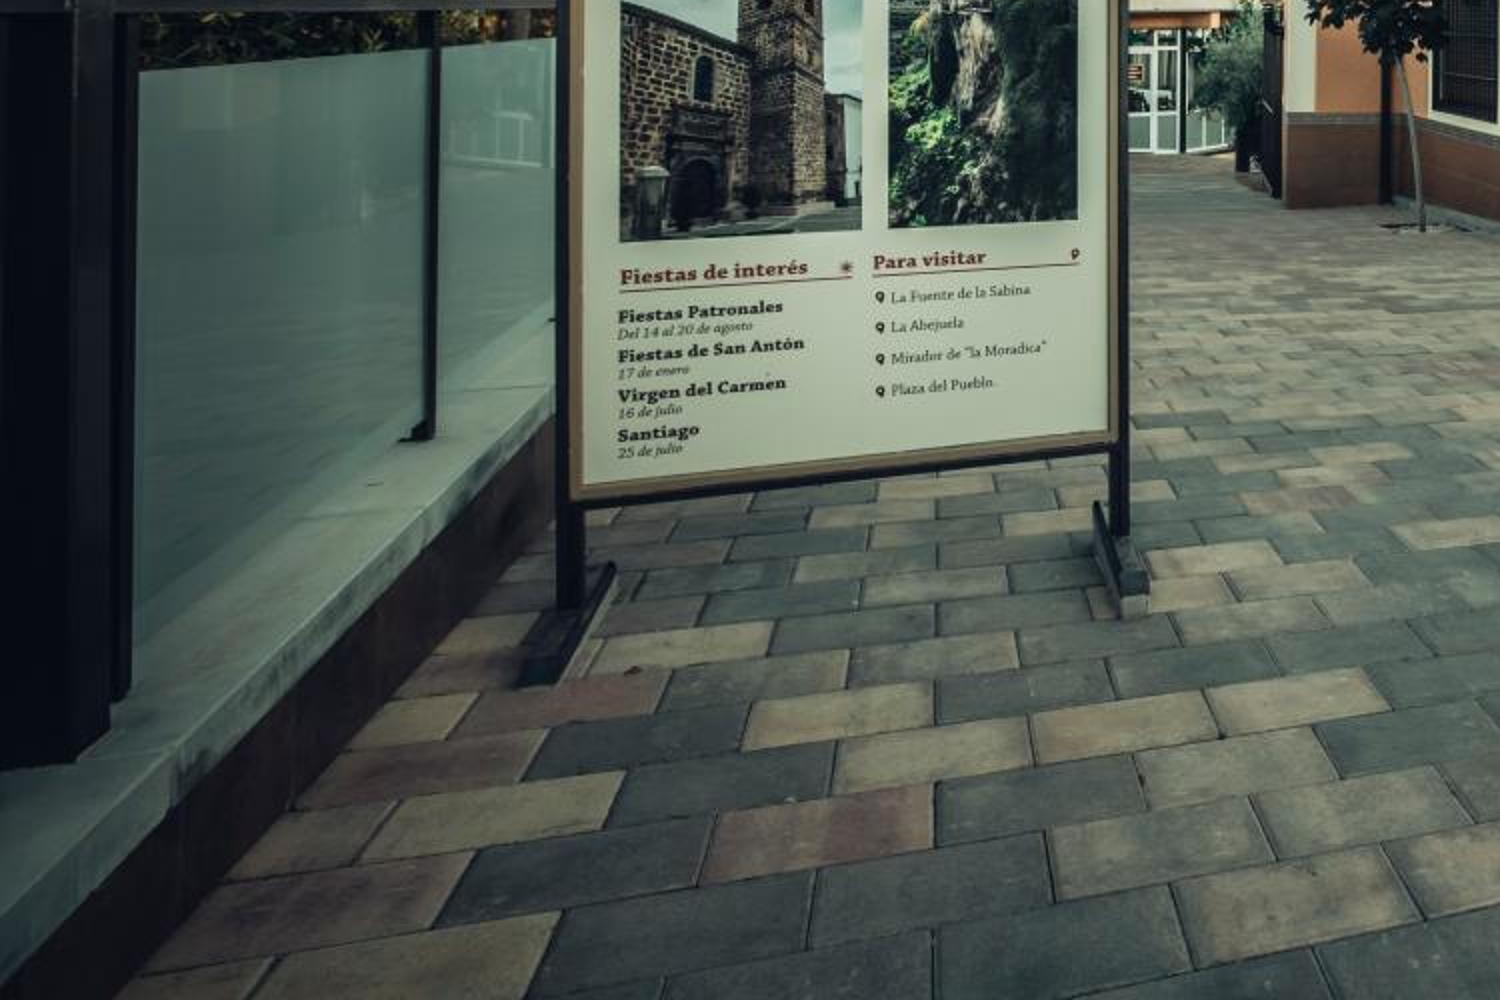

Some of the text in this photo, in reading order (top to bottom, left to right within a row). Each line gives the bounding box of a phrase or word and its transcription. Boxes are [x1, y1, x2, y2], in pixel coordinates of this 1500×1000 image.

[873, 250, 987, 270] Para visitar
[619, 260, 809, 286] Fiestas de interés
[891, 284, 1031, 304] La Fuente de la Sabina
[617, 300, 783, 325] Fiestas Patronales
[617, 321, 753, 341] Del 14 al 20 de agosto
[891, 316, 965, 333] La Abejuela
[618, 337, 805, 364] Fiestas de San Antón
[891, 350, 943, 365] Mirador
[946, 347, 962, 361] de
[617, 364, 690, 381] 17 de enero
[618, 379, 787, 405] Virgen del Carmen
[891, 384, 926, 397] Plaza
[928, 379, 948, 393] del
[618, 403, 684, 420] 16 de julio
[617, 425, 700, 443] Santiago
[616, 443, 684, 459] 25 de julio
